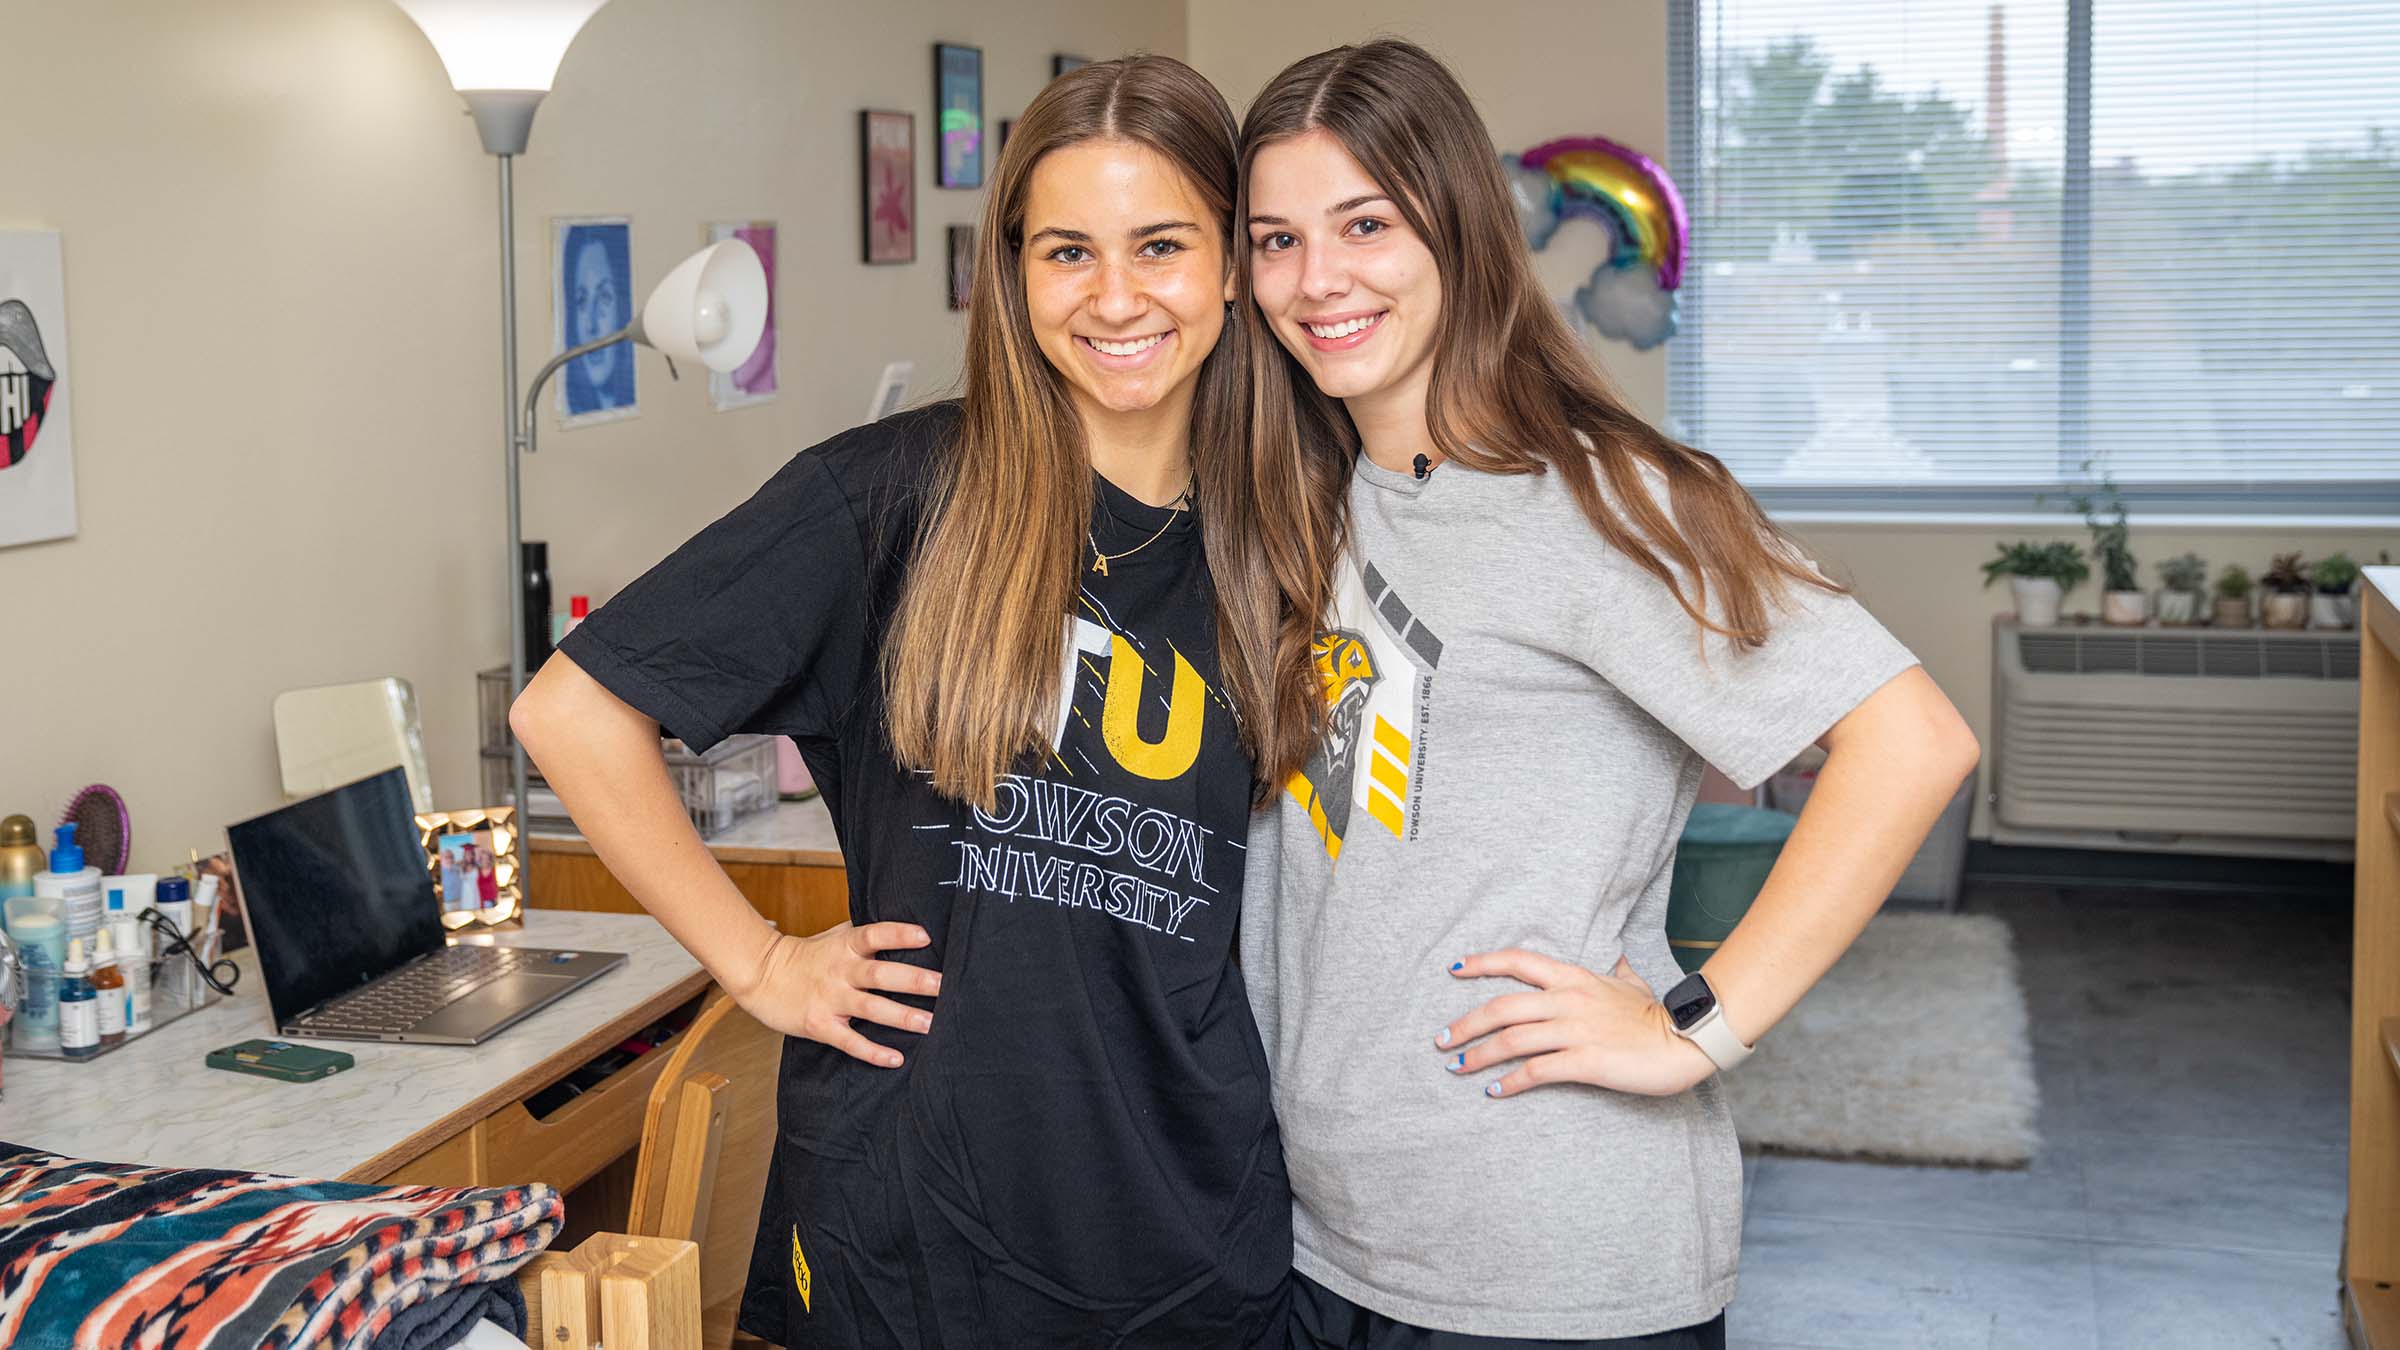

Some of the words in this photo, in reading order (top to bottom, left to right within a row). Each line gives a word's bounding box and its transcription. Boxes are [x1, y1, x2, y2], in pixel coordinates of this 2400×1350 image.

[1092, 553, 1109, 577] A
[1421, 675, 1433, 701] 1866
[1420, 703, 1431, 724] EST.
[1414, 728, 1429, 793] UNIVERSITY
[972, 776, 1208, 884] OWSON
[1410, 795, 1422, 842] TOWSON
[956, 842, 1200, 934] NIVERSITY
